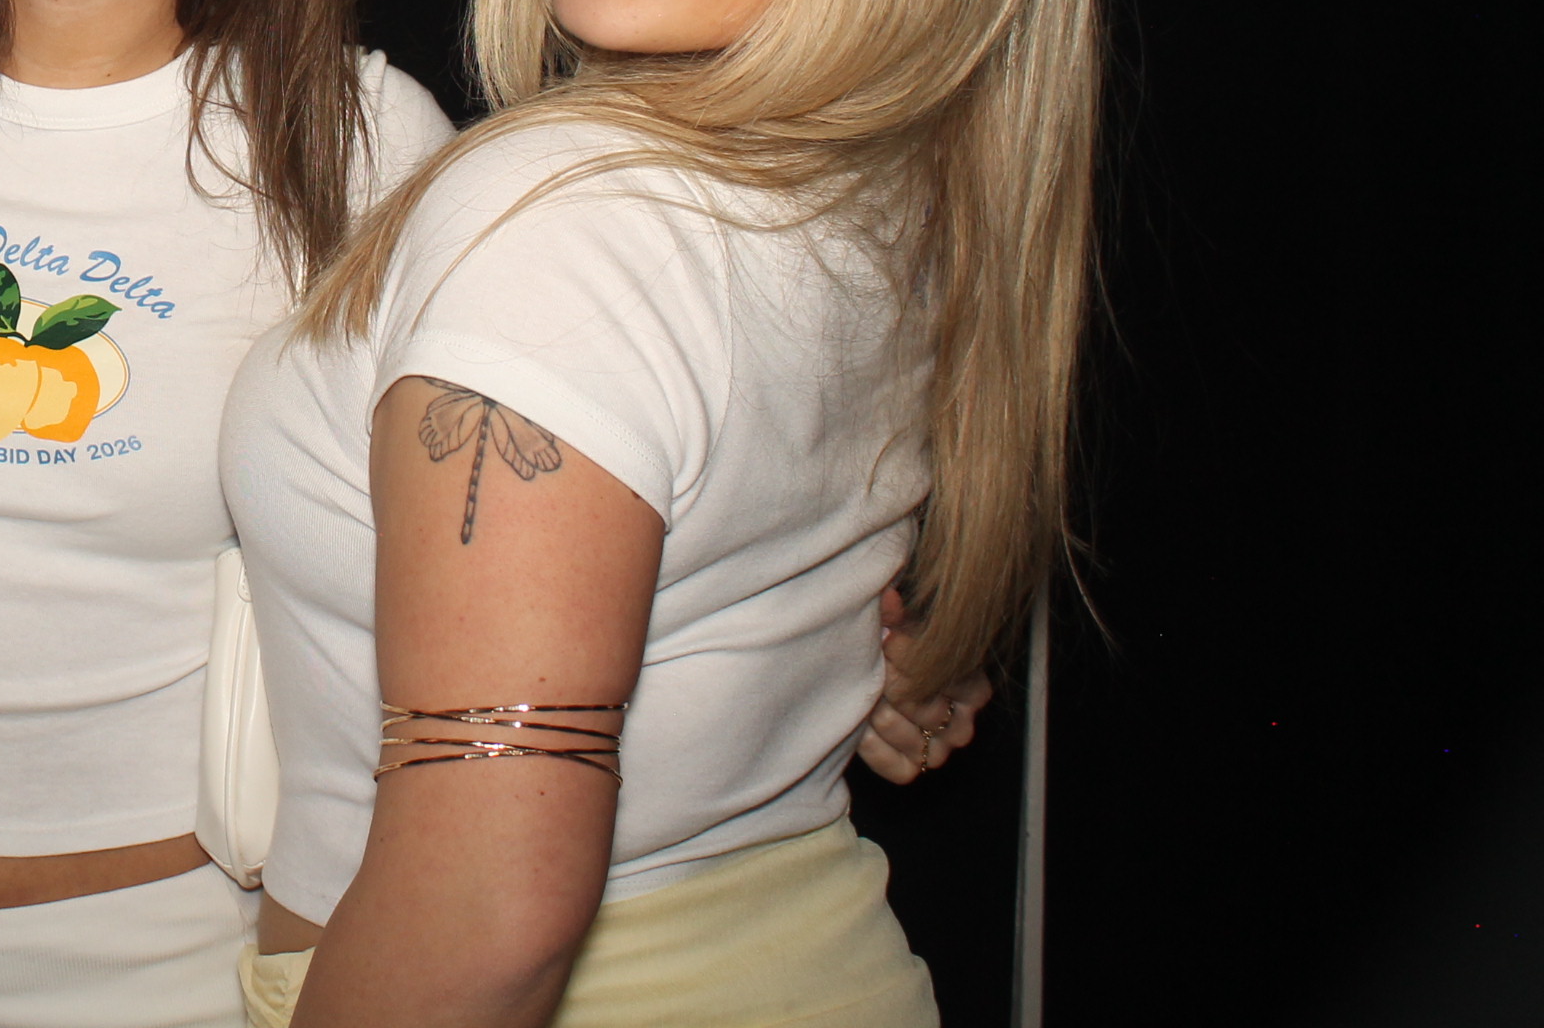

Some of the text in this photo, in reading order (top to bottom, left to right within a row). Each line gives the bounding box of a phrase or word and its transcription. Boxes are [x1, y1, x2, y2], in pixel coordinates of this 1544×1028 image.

[79, 250, 176, 319] Delta
[37, 447, 78, 465] DAY
[86, 435, 143, 460] 2026
